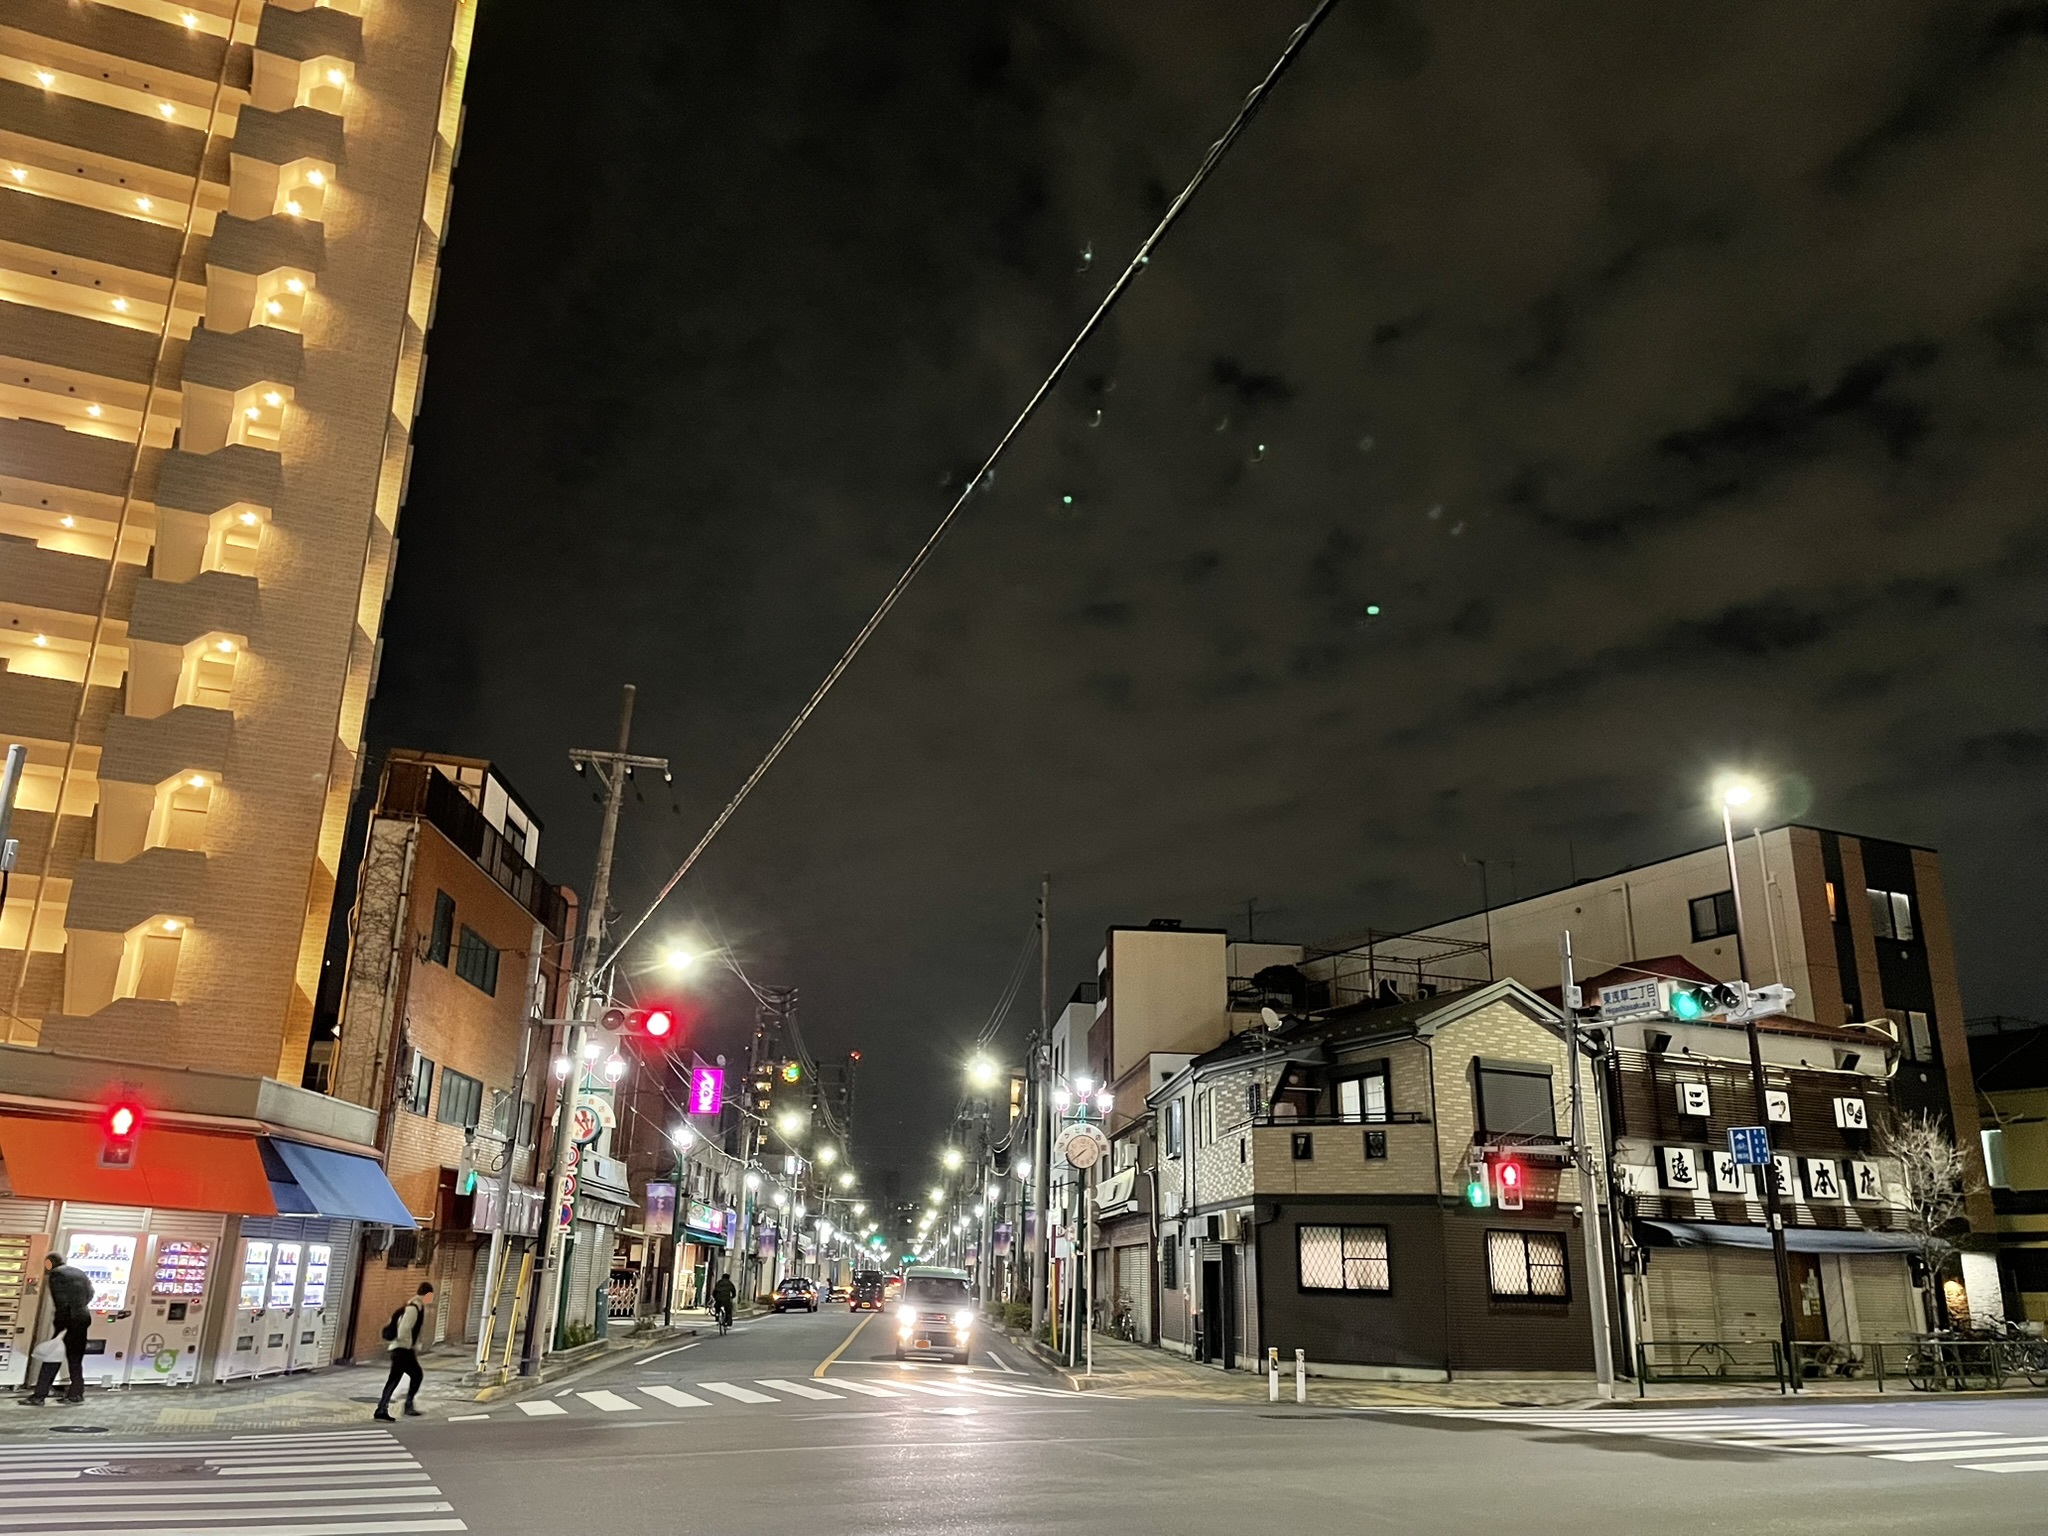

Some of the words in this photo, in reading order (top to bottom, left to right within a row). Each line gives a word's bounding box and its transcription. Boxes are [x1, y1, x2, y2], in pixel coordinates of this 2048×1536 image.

[1603, 983, 1657, 1004] 東浅草二丁目
